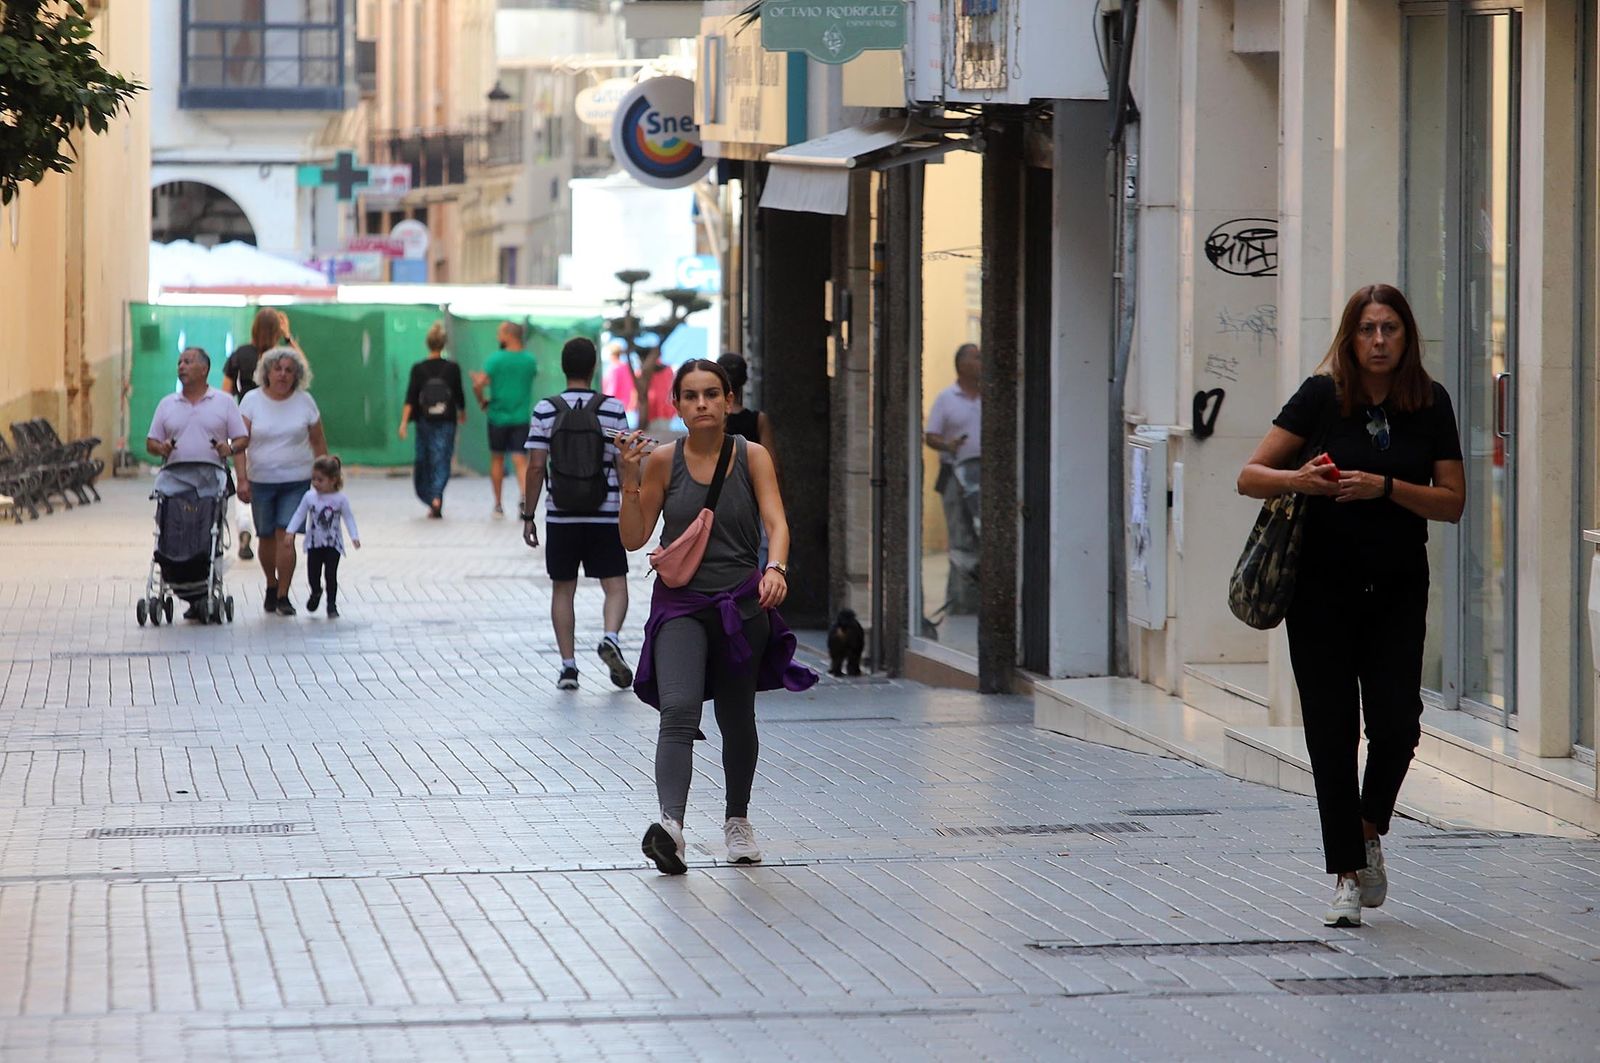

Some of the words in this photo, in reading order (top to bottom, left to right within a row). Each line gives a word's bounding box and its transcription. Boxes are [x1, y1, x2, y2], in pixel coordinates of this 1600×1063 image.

[769, 6, 822, 17] OCTAVIO
[826, 5, 898, 19] RODRIGUEZ
[646, 111, 700, 134] Sne
